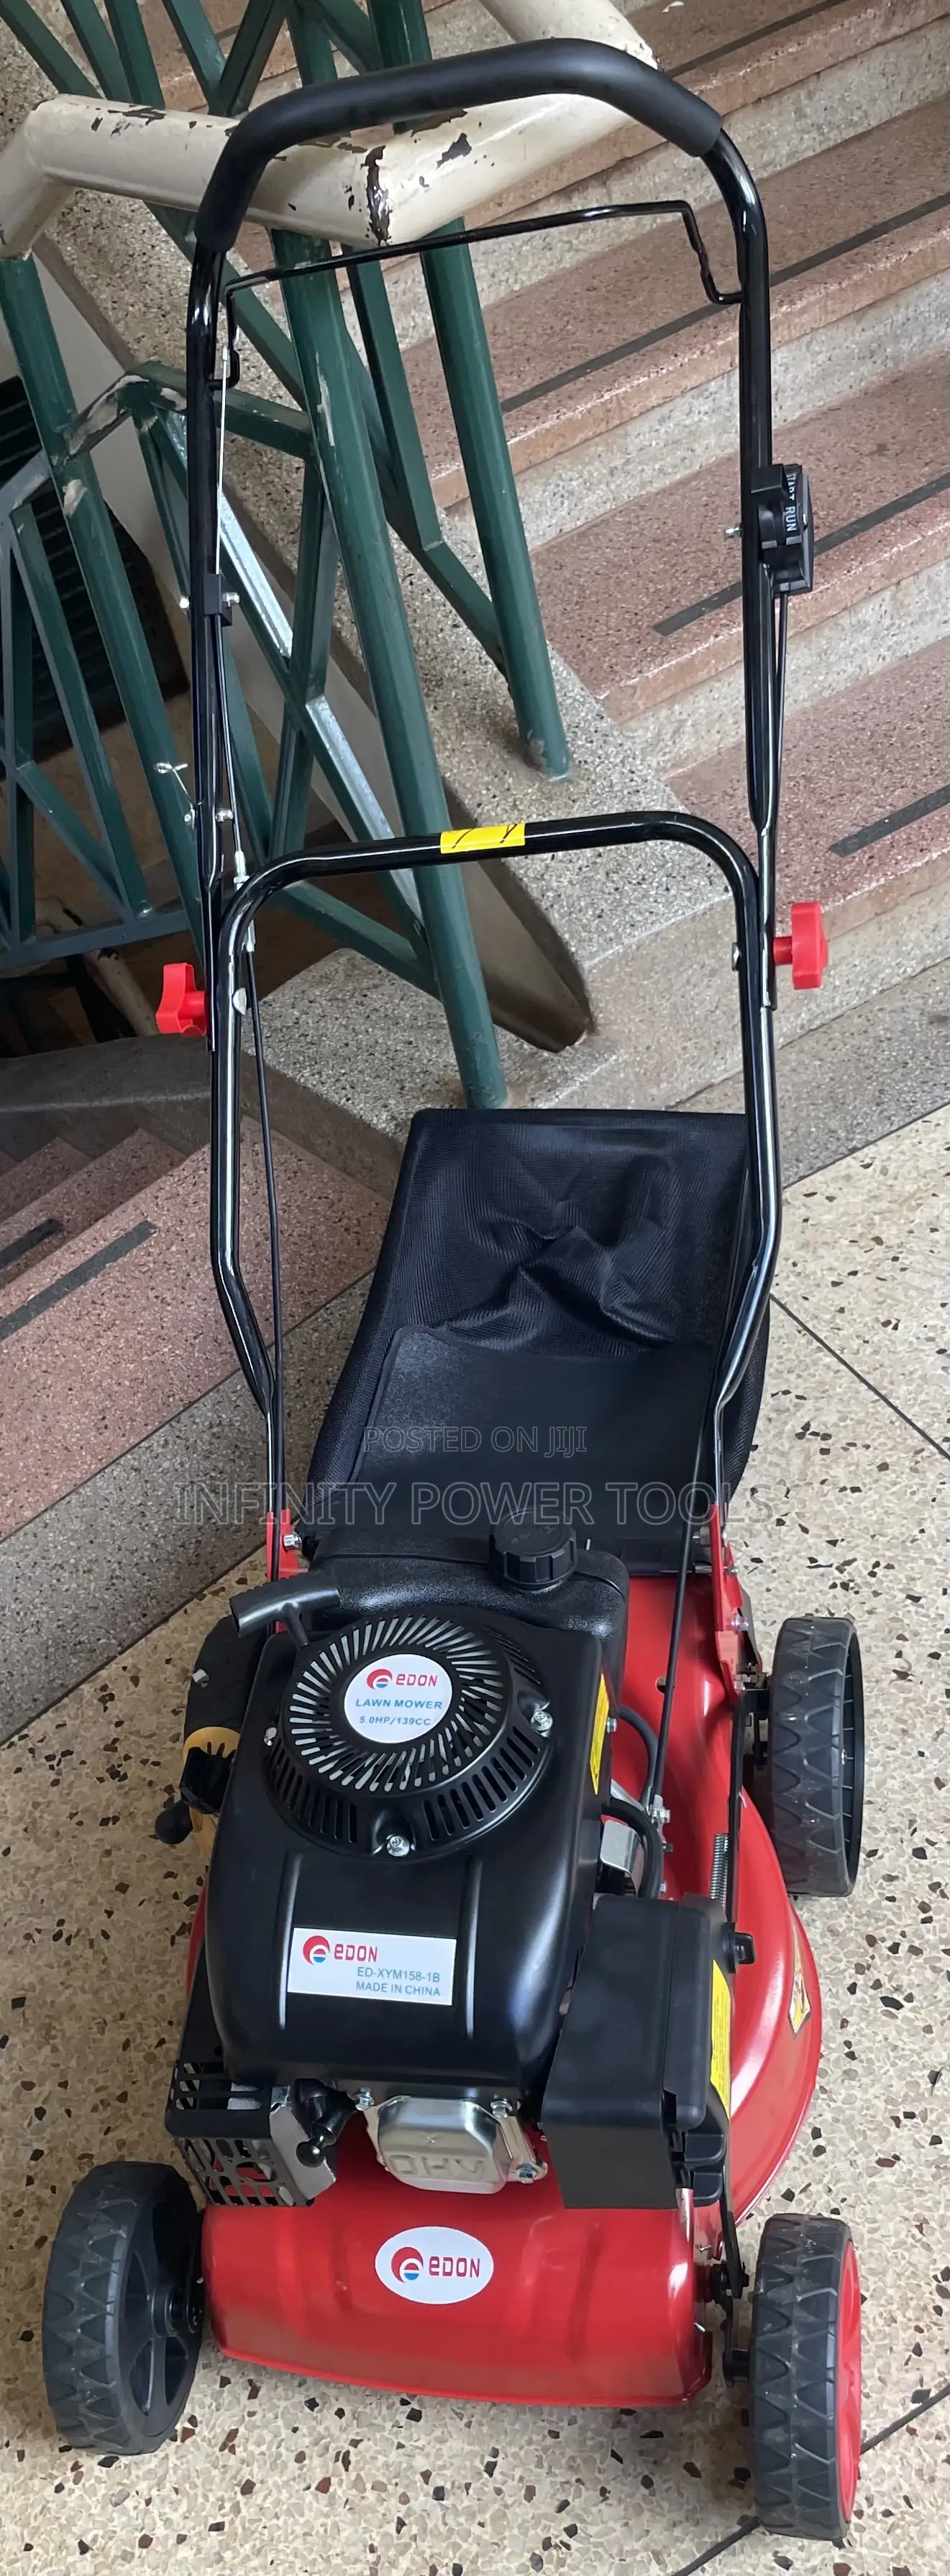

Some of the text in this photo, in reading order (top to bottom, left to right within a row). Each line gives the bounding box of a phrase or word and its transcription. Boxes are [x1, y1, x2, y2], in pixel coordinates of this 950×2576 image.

[785, 505, 798, 532] RUN
[355, 1698, 443, 1710] LAWN MOWER
[359, 1715, 431, 1726] 5.0HP/139CC
[357, 1966, 441, 1983] ED-XYM158-1B
[356, 1981, 441, 1997] MADE IN CHINA
